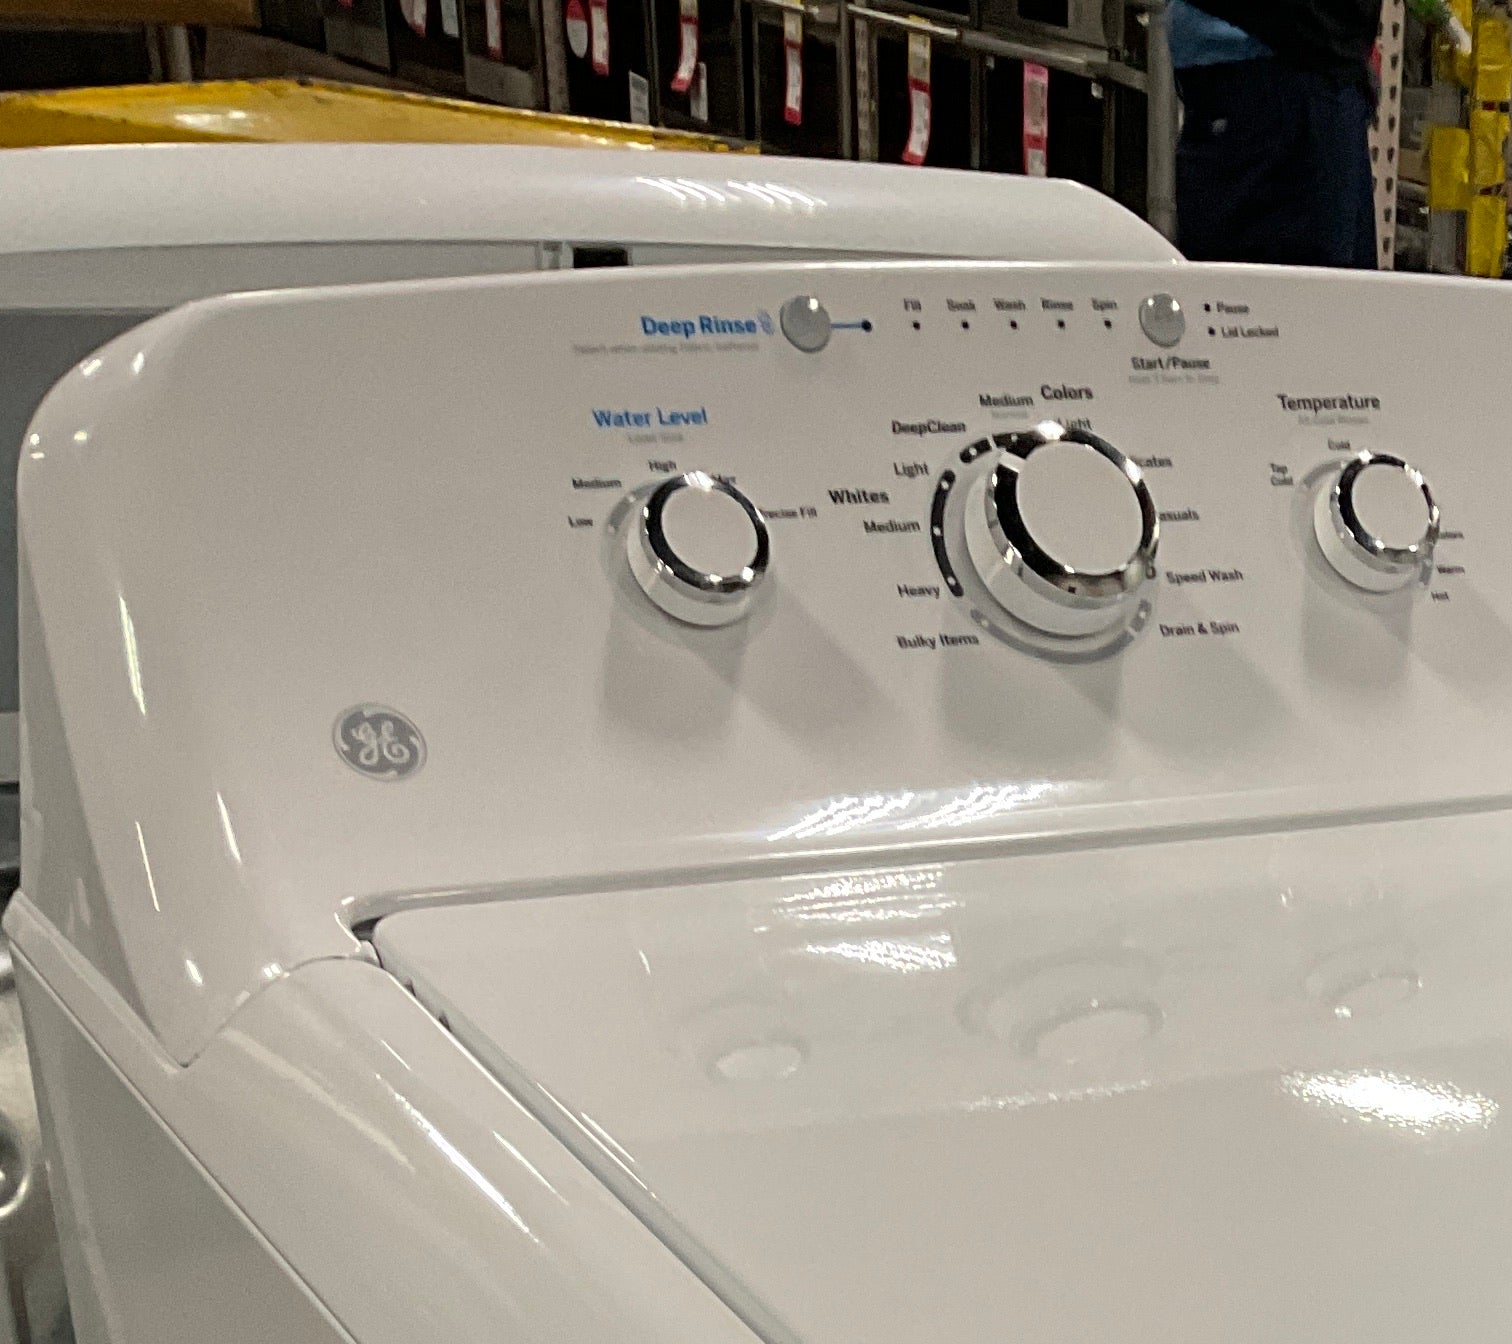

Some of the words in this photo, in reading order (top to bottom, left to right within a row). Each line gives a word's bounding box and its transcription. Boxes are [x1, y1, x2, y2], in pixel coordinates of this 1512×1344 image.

[1216, 301, 1249, 313] Pause
[641, 315, 696, 339] Deep
[699, 314, 757, 334] Rinse
[1240, 324, 1279, 338] Locked
[1131, 356, 1210, 371] Start/Pause
[979, 393, 1034, 407] Medium
[1040, 384, 1094, 401] Colors
[1276, 392, 1381, 415] Temperature
[592, 408, 651, 427] Water
[656, 405, 708, 426] Level
[891, 418, 967, 437] DeepClean
[648, 460, 677, 472] High
[893, 461, 930, 479] Light
[571, 477, 622, 490] Medium
[828, 488, 889, 504] Whites
[568, 515, 594, 529] Low
[1158, 507, 1199, 521] asuals
[863, 519, 921, 534] Medium
[1166, 571, 1206, 587] Speed
[1209, 569, 1243, 583] Wash
[897, 583, 940, 600] Heavy
[1159, 623, 1195, 638] Drain
[1198, 623, 1208, 635] &
[1210, 620, 1240, 637] Spin
[897, 634, 936, 651] Bulky
[939, 632, 980, 647] Items
